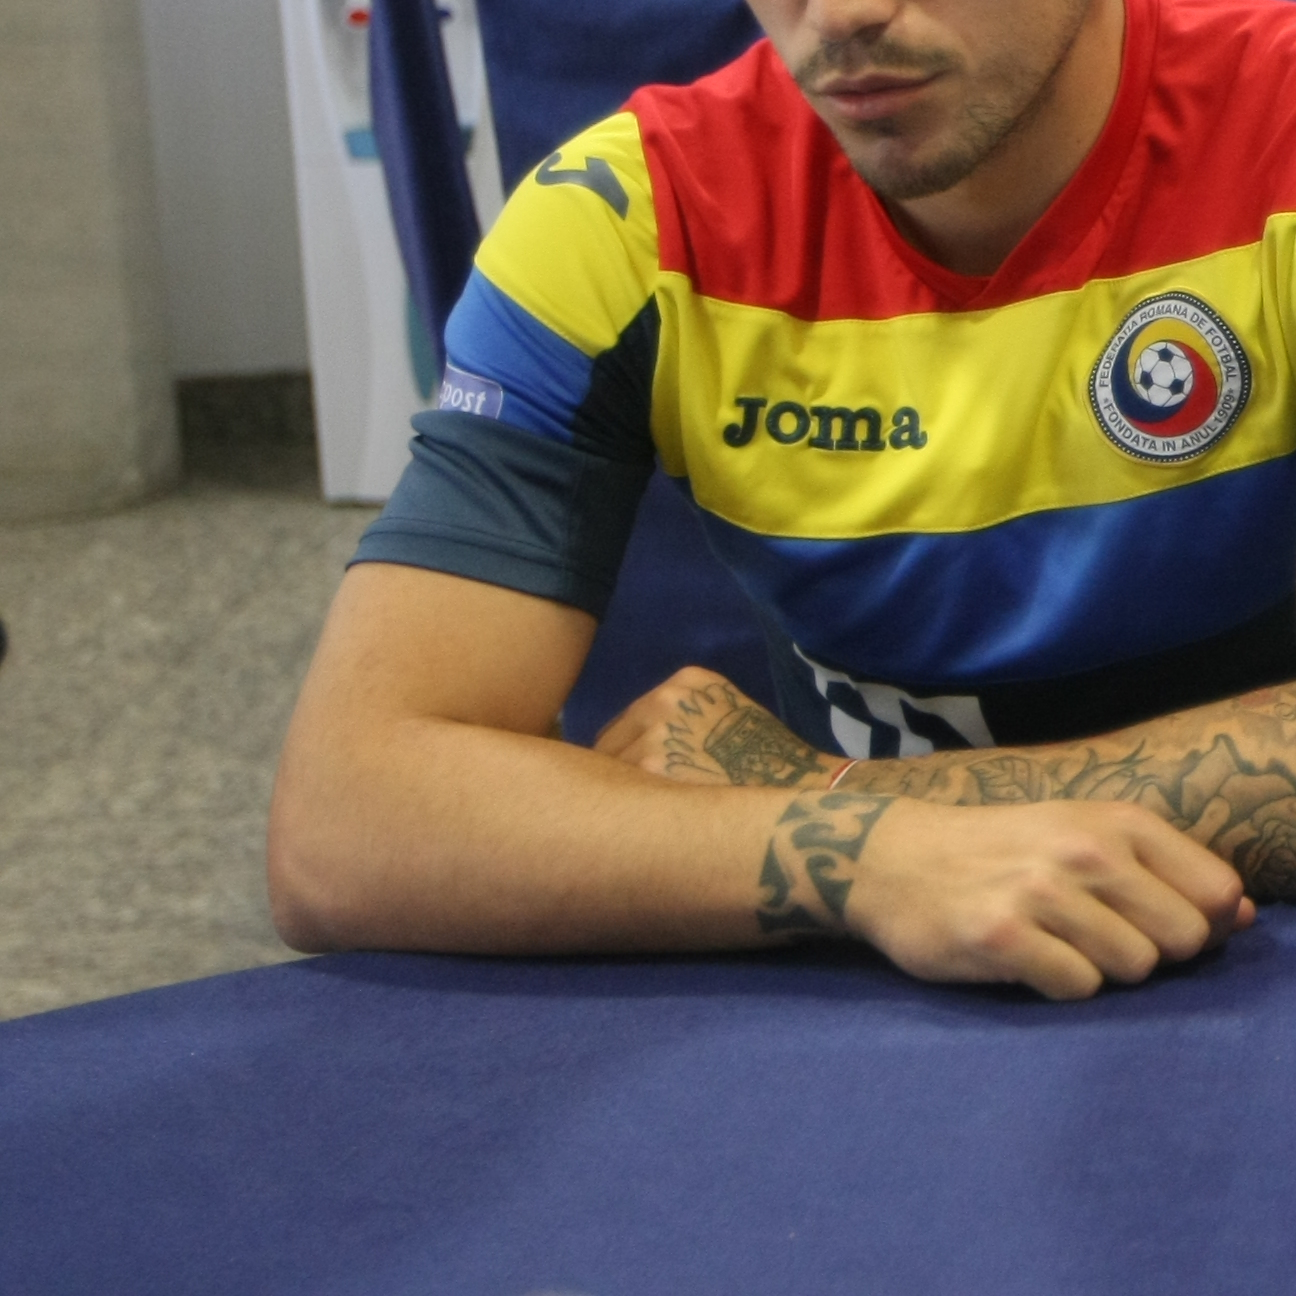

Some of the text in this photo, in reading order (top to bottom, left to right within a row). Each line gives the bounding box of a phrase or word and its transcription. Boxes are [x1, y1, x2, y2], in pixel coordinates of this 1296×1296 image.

[1191, 312, 1208, 330] DE
[1205, 328, 1237, 382] FOTBAL
[1102, 393, 1236, 452] FONDATA IN ANUL 1909
